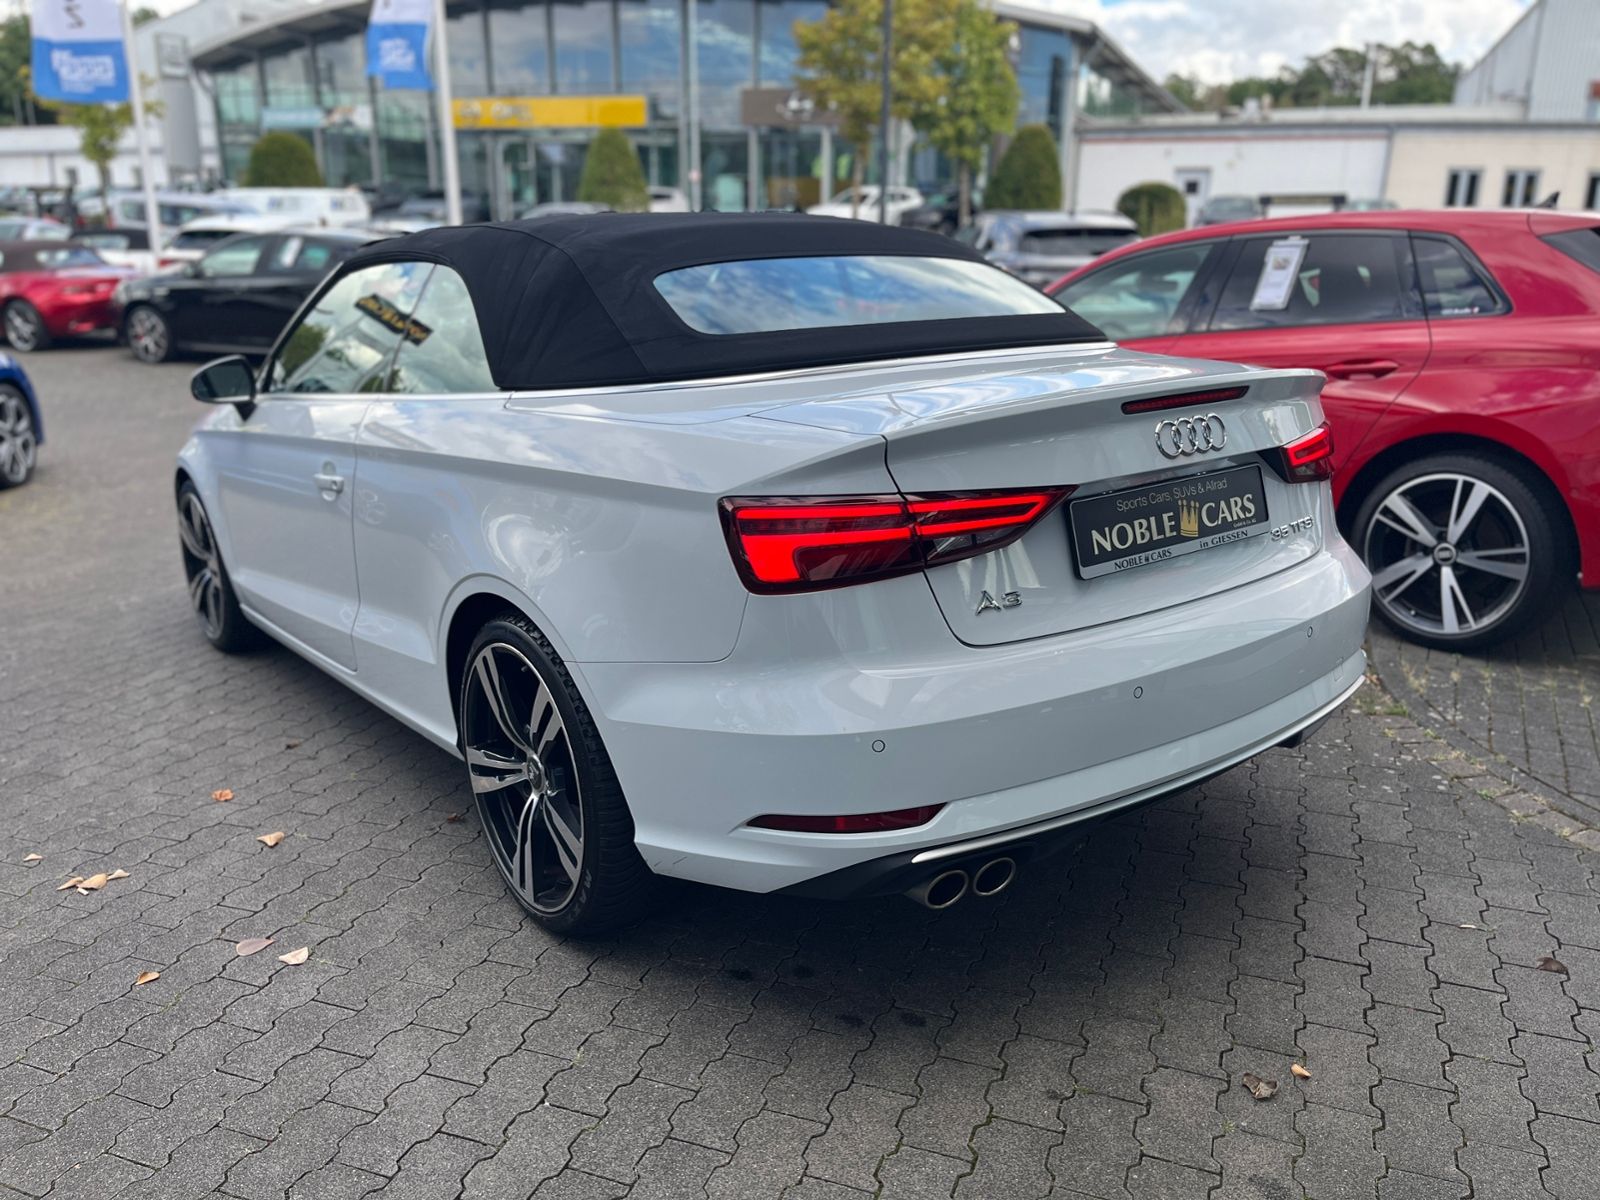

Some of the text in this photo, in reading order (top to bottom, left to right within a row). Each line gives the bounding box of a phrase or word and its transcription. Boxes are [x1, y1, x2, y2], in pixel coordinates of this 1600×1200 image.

[1116, 496, 1148, 513] Sports
[1149, 492, 1173, 504] Cars,
[1173, 485, 1197, 499] SUVs
[1197, 482, 1205, 494] &
[1091, 493, 1256, 556] NOBLE CARS
[1271, 525, 1289, 541] 35
[1200, 530, 1249, 549] in GIESSEN
[1114, 547, 1173, 571] NOBLE CARS
[975, 590, 1022, 616] A3
